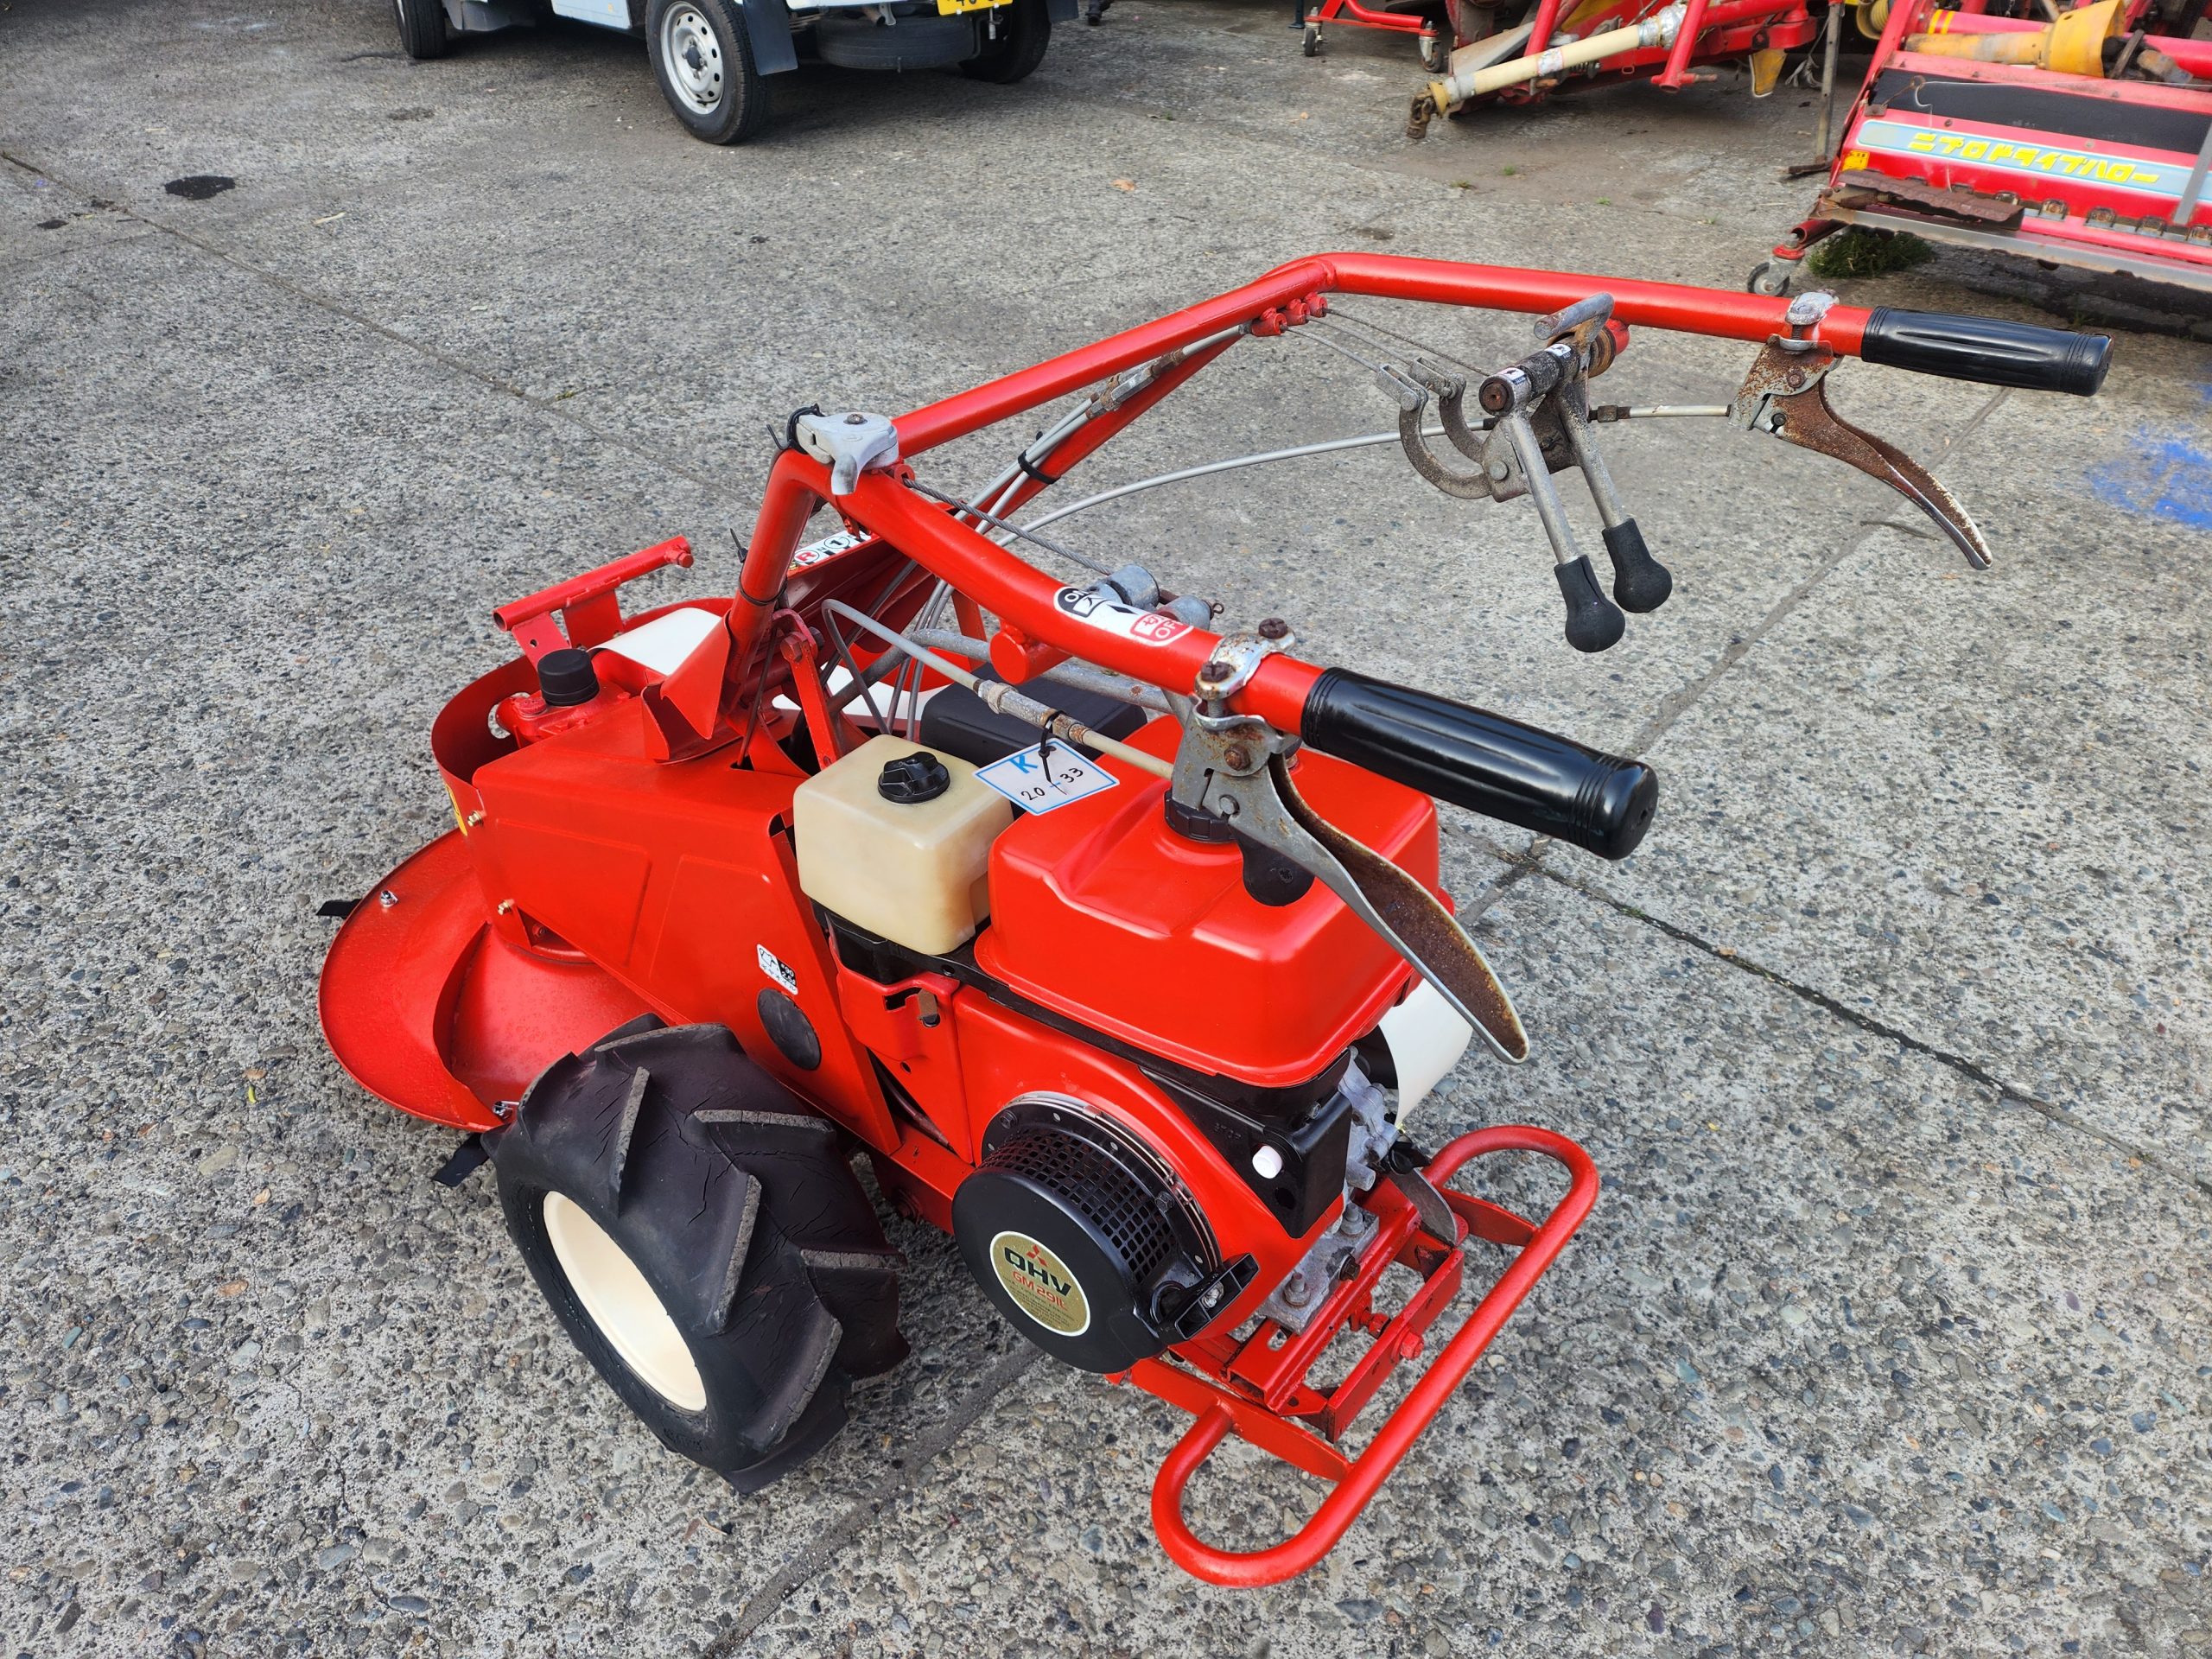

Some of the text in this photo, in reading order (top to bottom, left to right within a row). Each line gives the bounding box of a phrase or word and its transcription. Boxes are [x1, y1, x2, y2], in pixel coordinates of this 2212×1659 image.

[1908, 133, 2159, 183] ニプロドライブハロー
[1009, 754, 1038, 774] K
